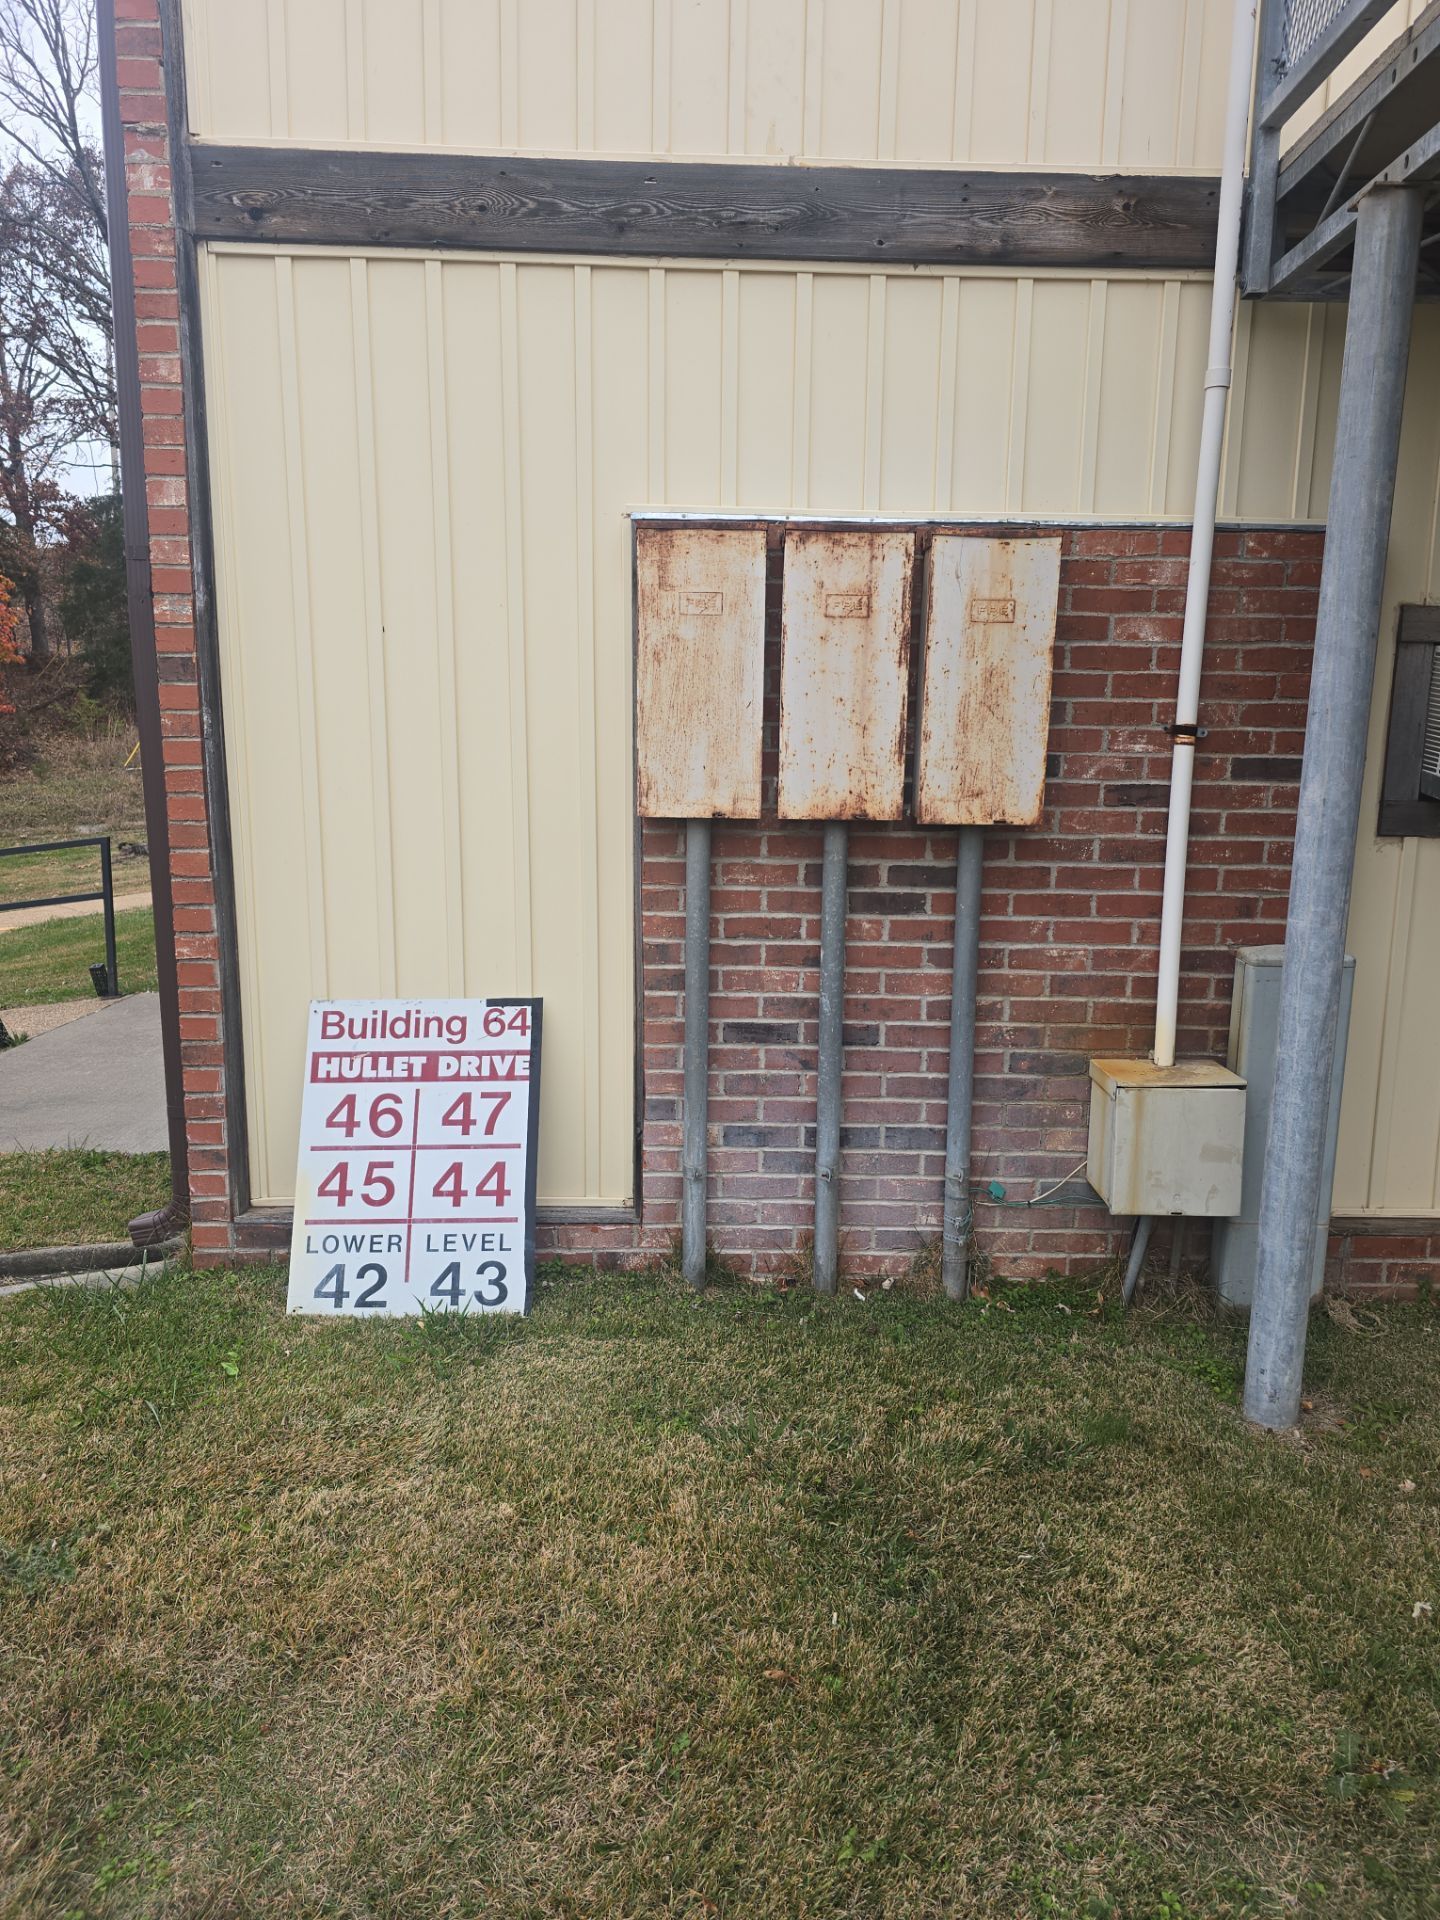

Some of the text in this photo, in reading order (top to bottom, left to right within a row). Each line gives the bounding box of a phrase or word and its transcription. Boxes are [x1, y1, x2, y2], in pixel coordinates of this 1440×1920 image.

[320, 1007, 531, 1045] Building 64
[317, 1055, 530, 1079] HULLET DRIVE
[325, 1092, 404, 1139] 46
[441, 1091, 512, 1136] 47
[317, 1160, 396, 1208] 45
[432, 1161, 512, 1208] 44
[306, 1233, 513, 1254] LOWER LEVEL
[313, 1262, 389, 1309] 42
[429, 1260, 509, 1308] 43
